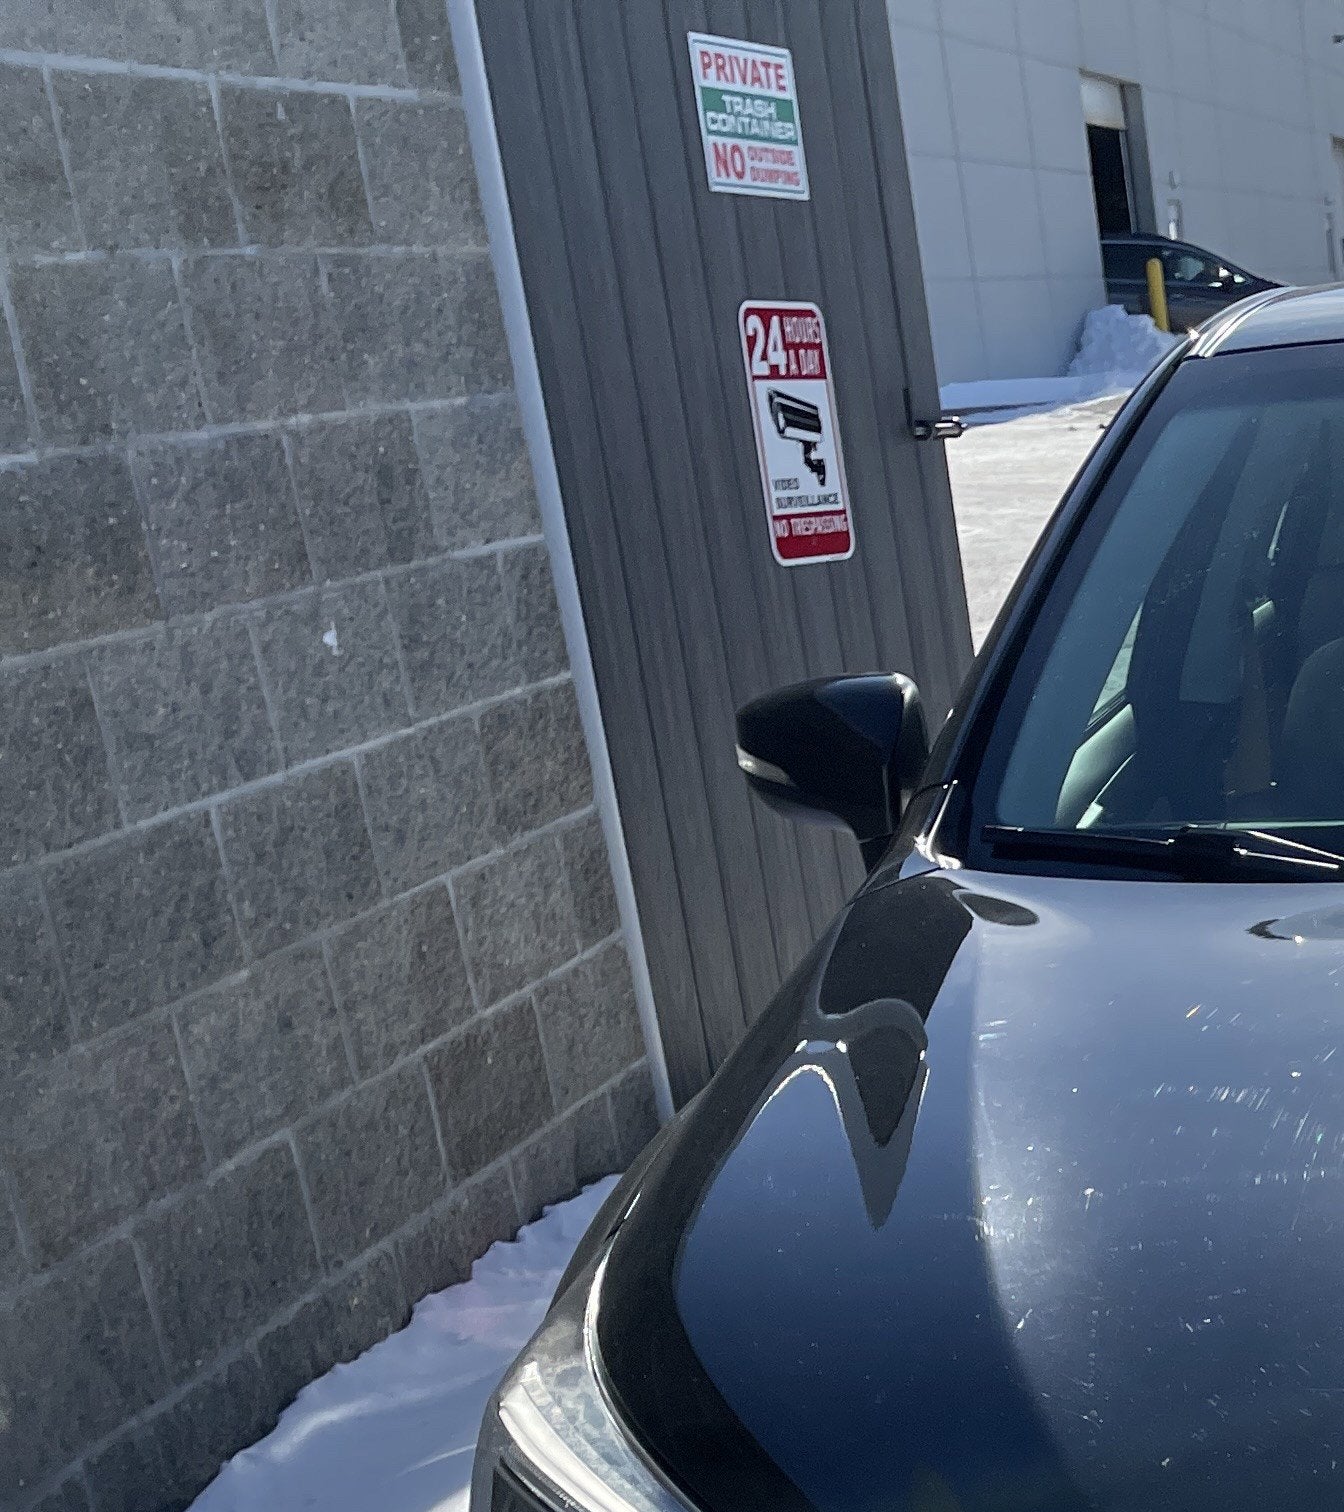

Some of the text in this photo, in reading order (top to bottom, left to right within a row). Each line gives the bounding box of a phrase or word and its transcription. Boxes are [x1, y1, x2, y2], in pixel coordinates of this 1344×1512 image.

[700, 50, 787, 92] PRIVATE
[722, 95, 777, 121] TRASH
[706, 111, 797, 140] CONTAINER
[713, 142, 746, 180] NO
[783, 316, 821, 343] HOURS
[745, 314, 787, 376] 24
[798, 348, 821, 376] DAY
[772, 477, 800, 491] VIDEO
